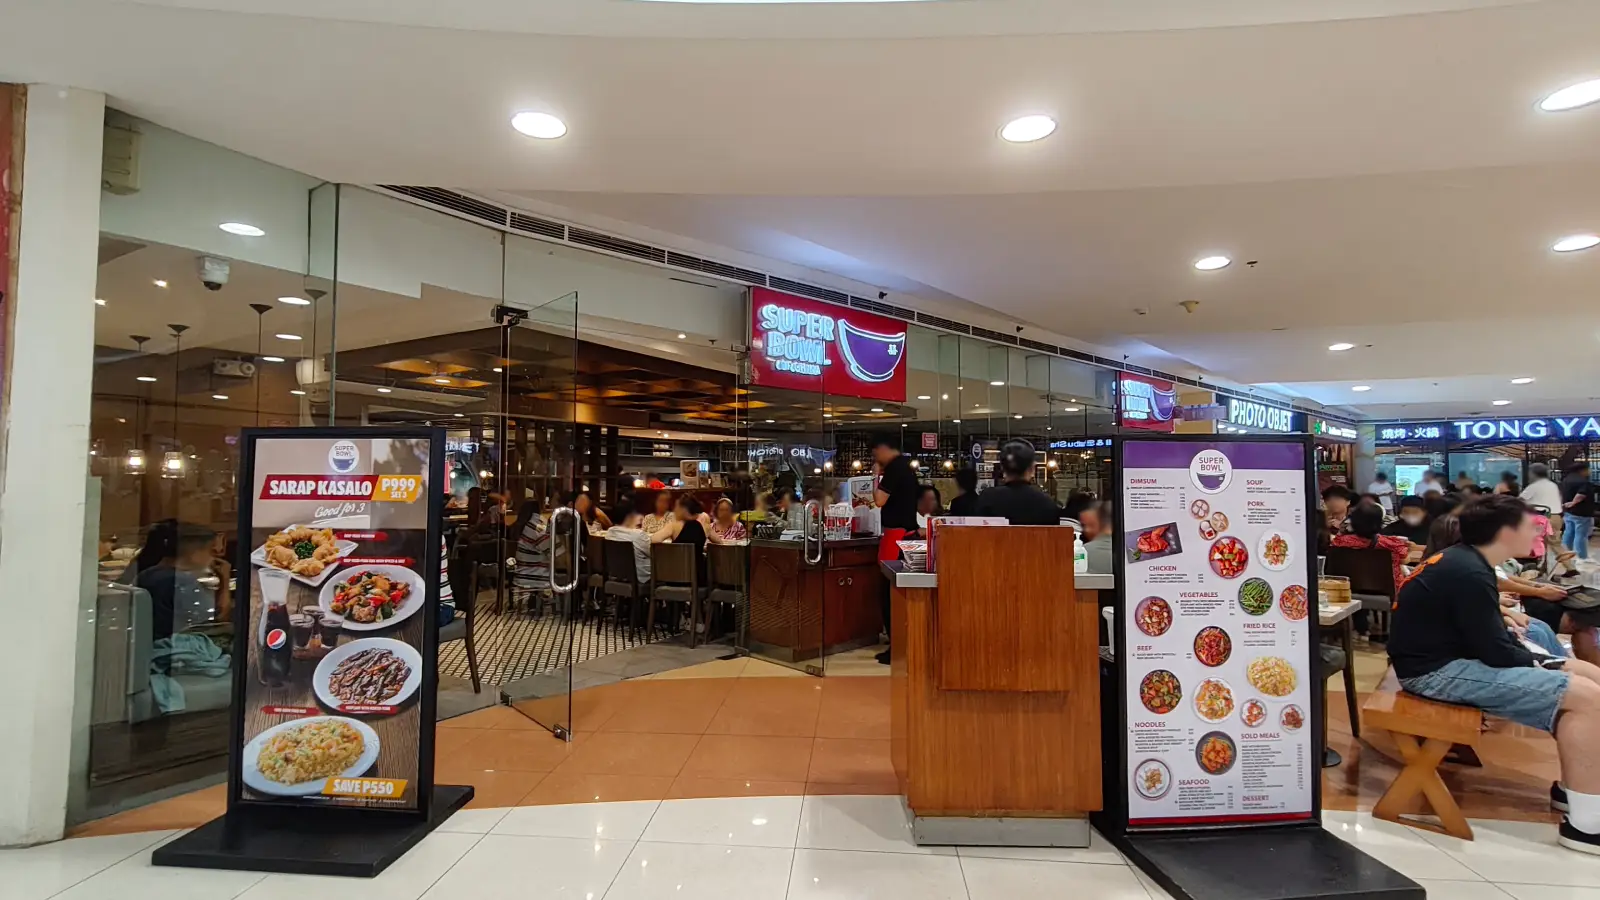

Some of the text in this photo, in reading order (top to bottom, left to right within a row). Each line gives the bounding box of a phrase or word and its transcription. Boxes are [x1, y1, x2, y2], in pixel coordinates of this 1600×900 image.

[758, 304, 834, 341] SUPER
[764, 331, 832, 365] BOWL
[1230, 399, 1266, 427] PHOTO
[1267, 408, 1293, 432] OBJET
[1453, 417, 1600, 439] TONG YA
[1200, 464, 1223, 472] BOWL
[269, 480, 372, 496] SARAP KASALO
[382, 478, 416, 491] P999
[391, 491, 401, 499] SET
[315, 503, 366, 518] Good for 3
[333, 779, 394, 795] SAVE P550
[1178, 778, 1210, 786] SEAFOOD
[1242, 794, 1269, 802] DESSERT
